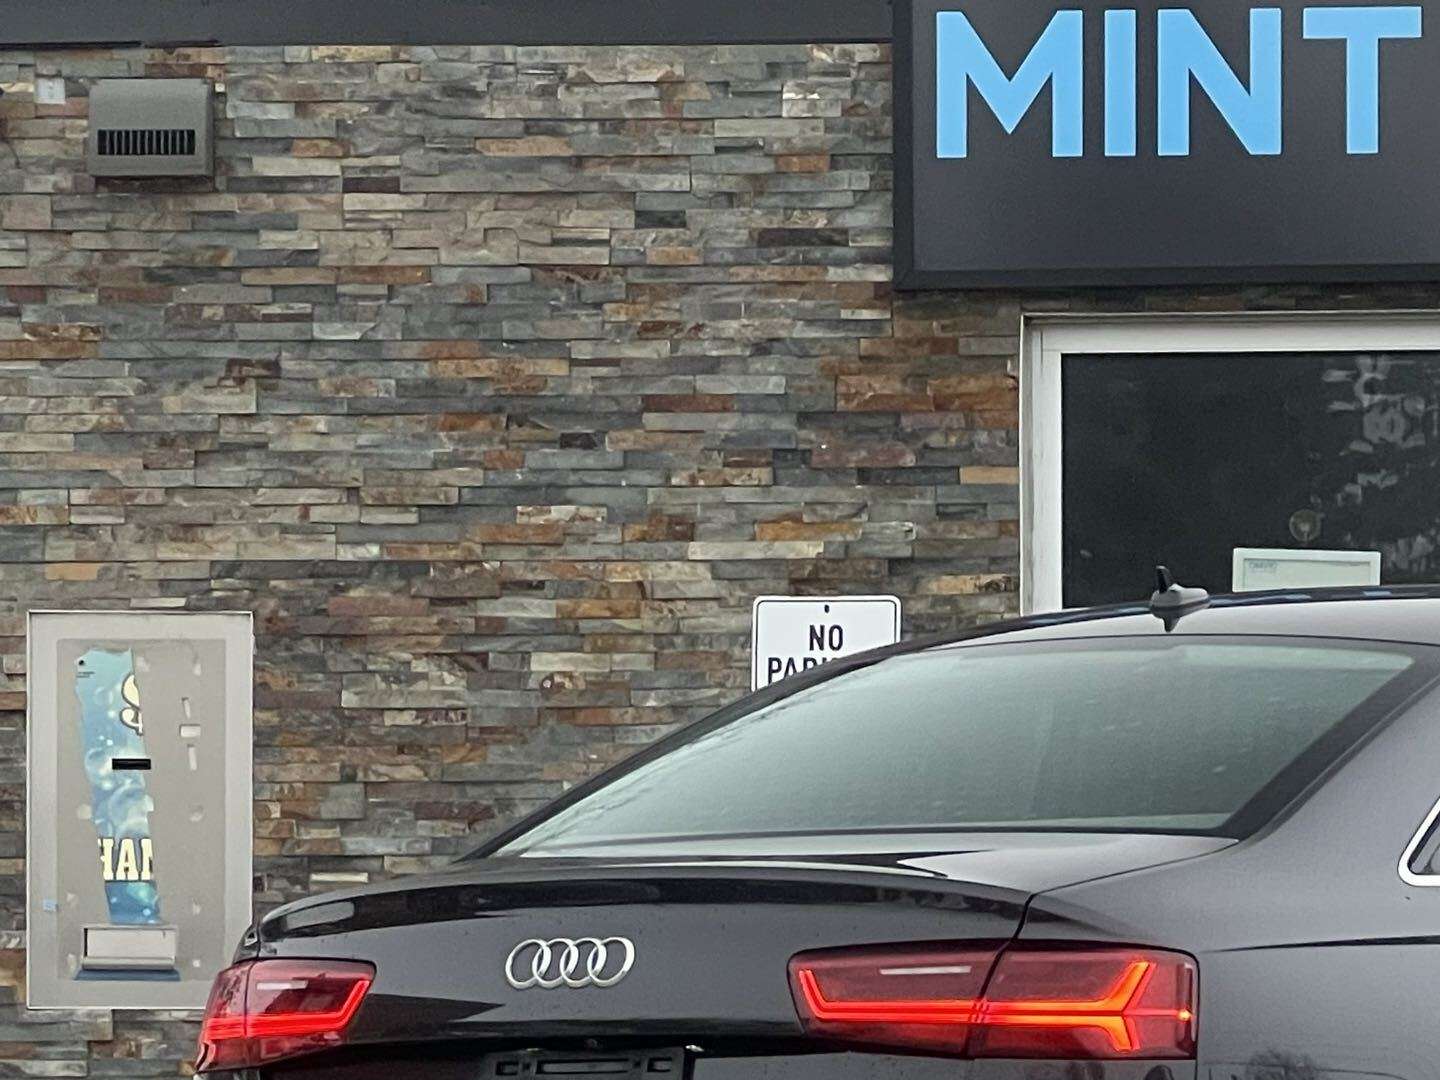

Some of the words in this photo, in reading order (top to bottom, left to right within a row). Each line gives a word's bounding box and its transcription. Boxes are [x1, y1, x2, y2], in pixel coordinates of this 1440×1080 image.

[936, 6, 1423, 159] MINT
[809, 624, 844, 651] NO
[767, 656, 828, 685] PAR
